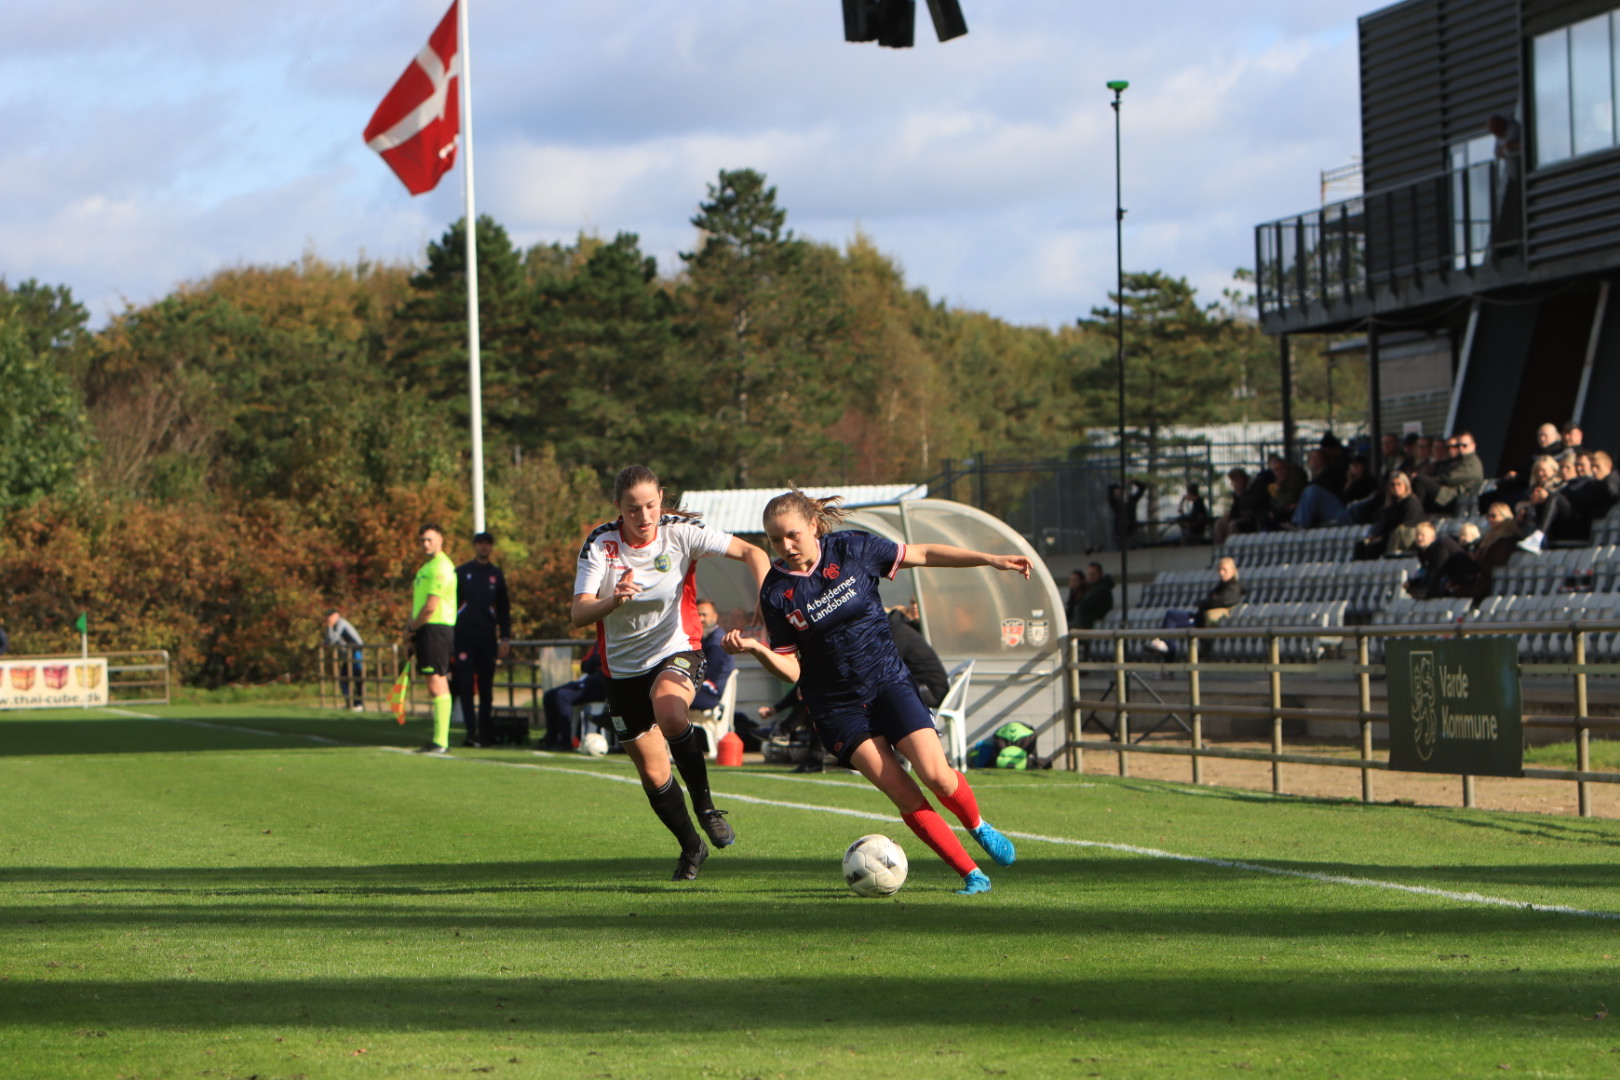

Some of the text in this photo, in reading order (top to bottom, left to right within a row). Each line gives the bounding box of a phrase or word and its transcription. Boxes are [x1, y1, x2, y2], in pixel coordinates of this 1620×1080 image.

[806, 575, 856, 613] Arbejdernes
[810, 587, 857, 622] Landsbank
[1439, 664, 1469, 698] Varde
[1441, 705, 1498, 740] Kommune
